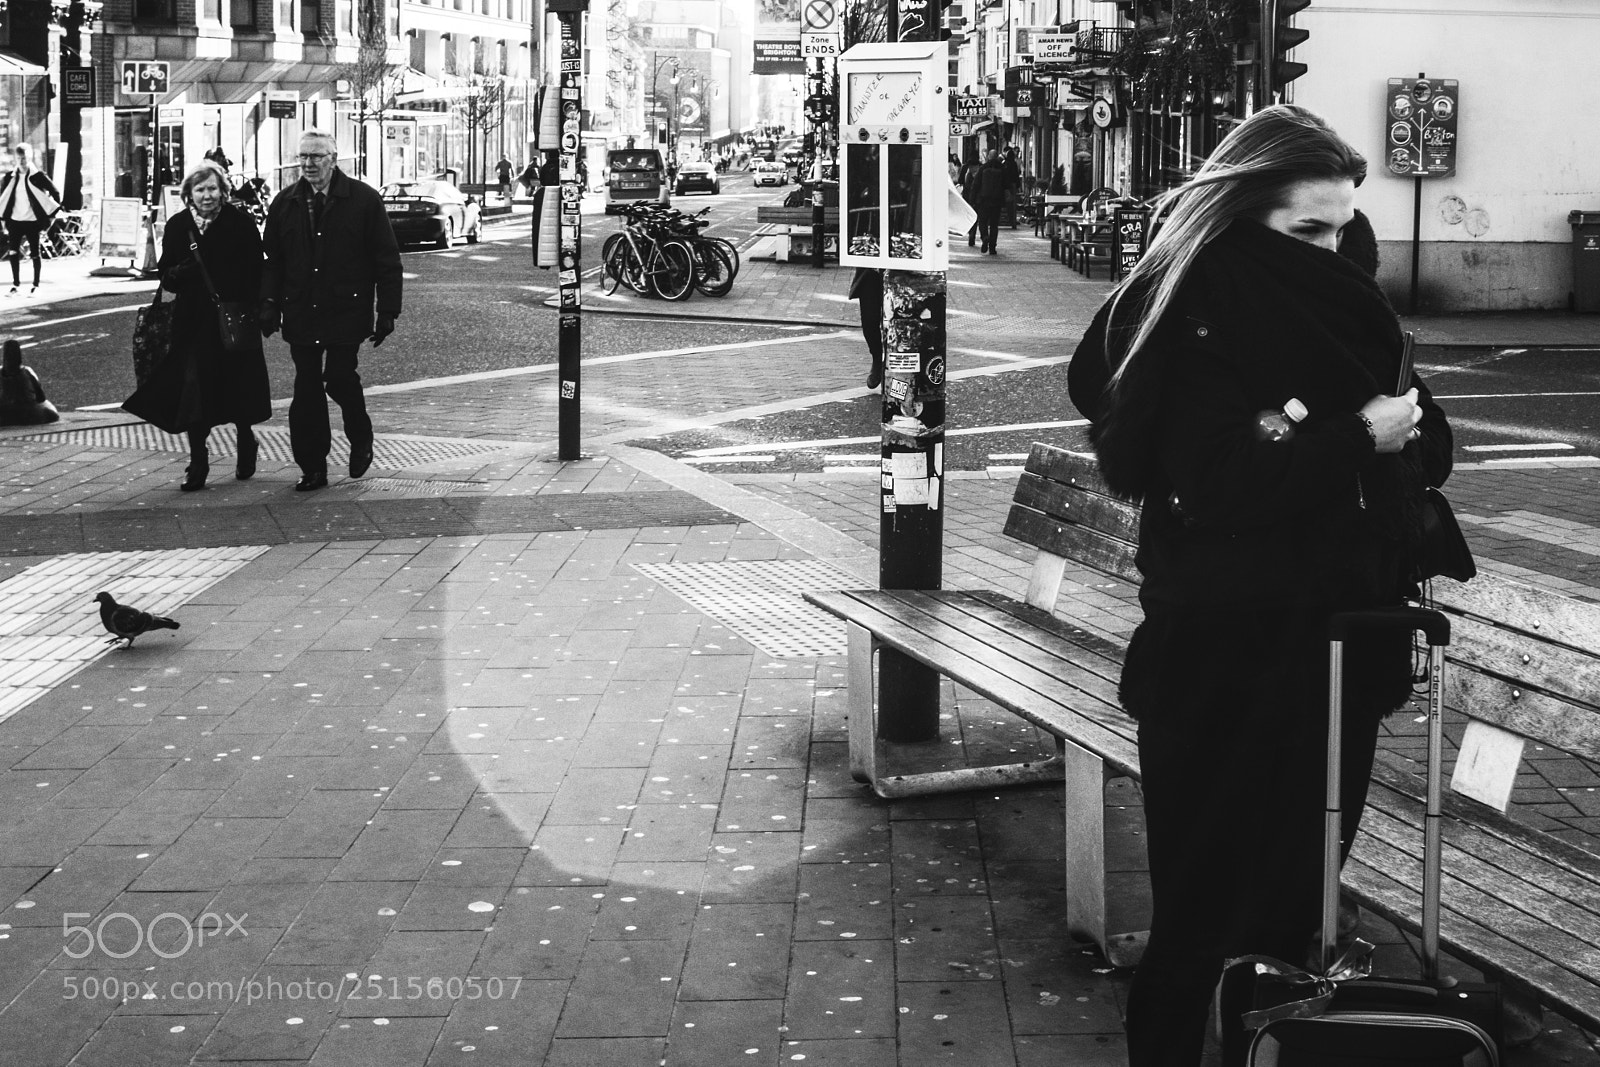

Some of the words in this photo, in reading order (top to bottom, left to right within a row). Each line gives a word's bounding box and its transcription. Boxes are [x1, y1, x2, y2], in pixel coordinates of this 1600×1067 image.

[810, 36, 830, 44] Zone
[805, 46, 835, 54] ENDS
[960, 98, 986, 107] TAXI
[1120, 222, 1142, 234] CRA
[1432, 676, 1440, 719] decent
